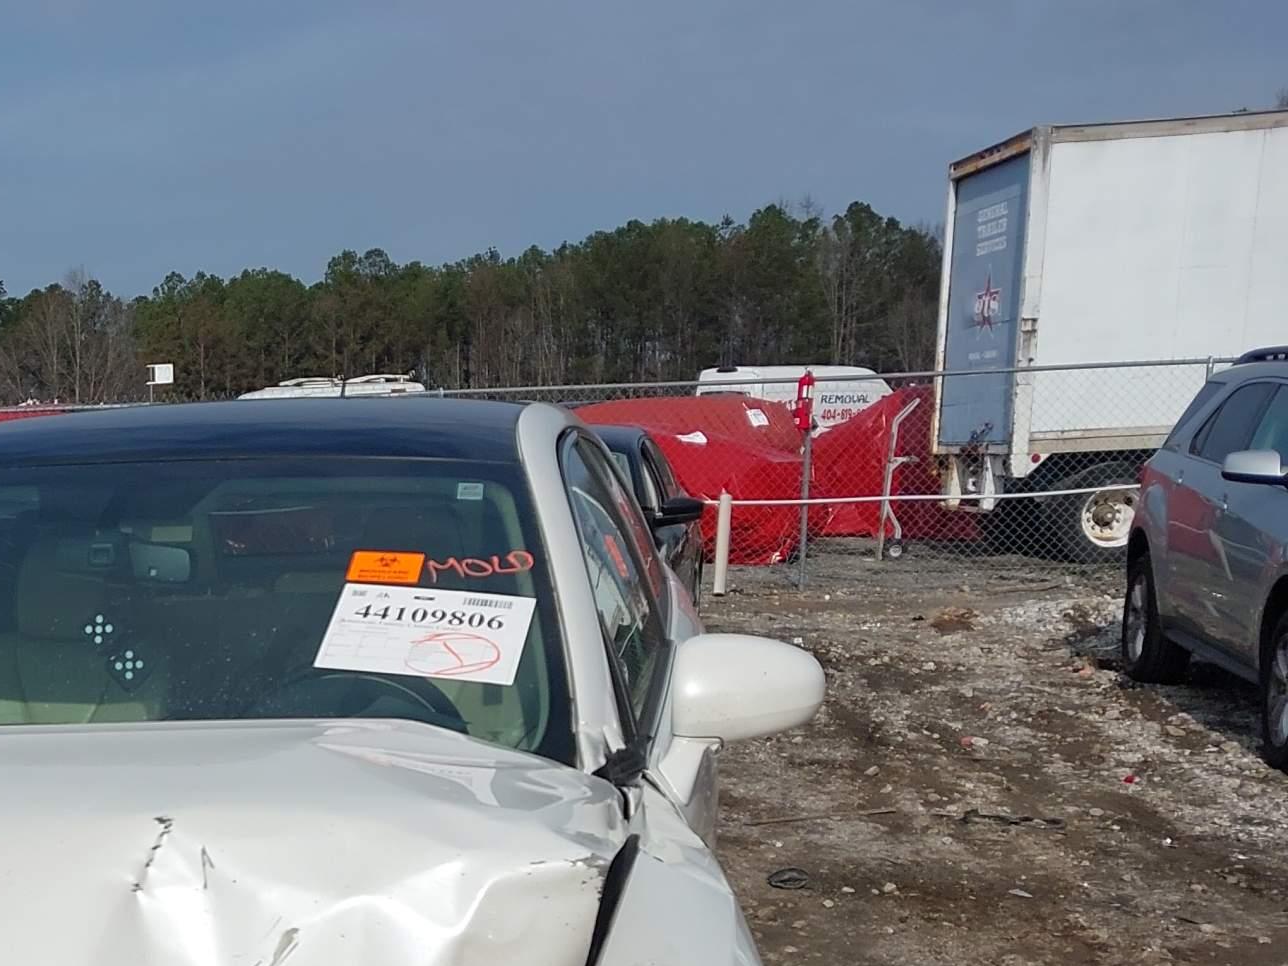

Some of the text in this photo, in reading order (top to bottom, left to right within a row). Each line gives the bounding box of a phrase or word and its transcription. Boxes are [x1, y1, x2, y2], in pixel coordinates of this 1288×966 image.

[820, 394, 871, 404] REMOVAL
[427, 550, 534, 584] MOLD
[354, 604, 506, 631] 44109806
